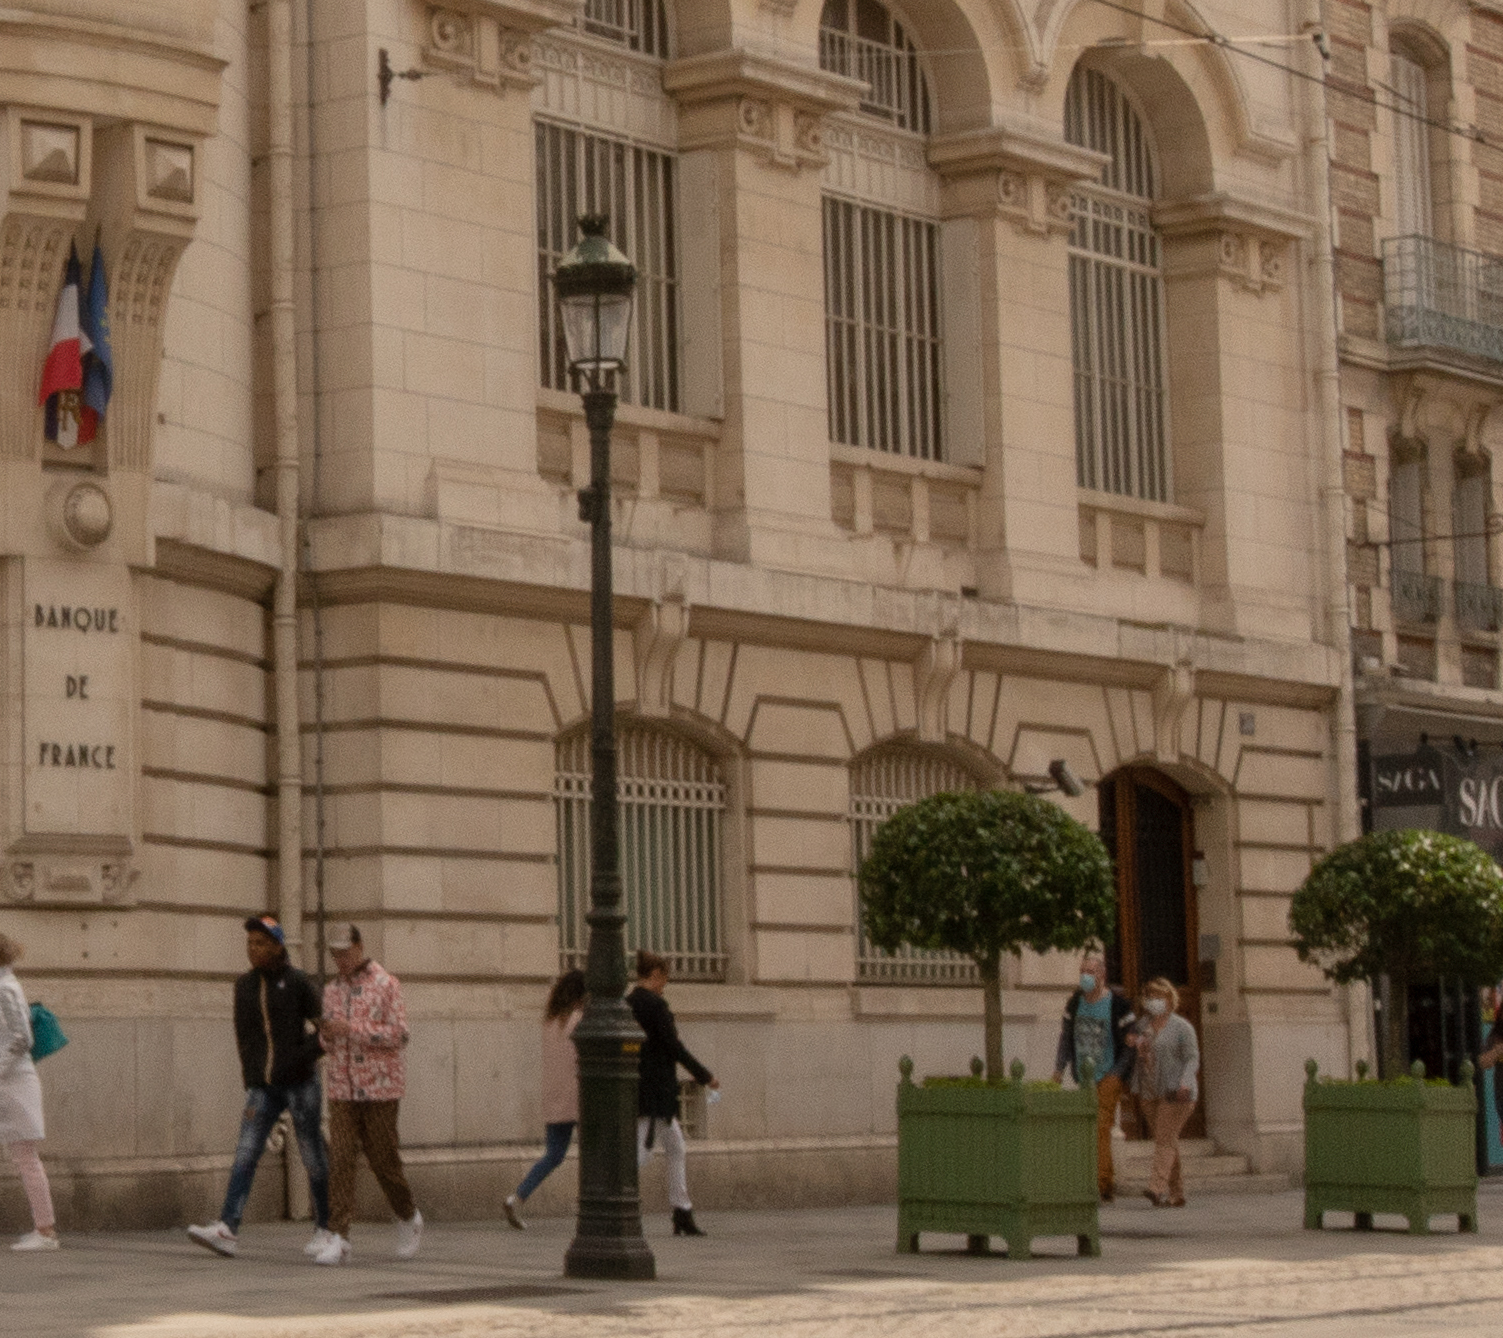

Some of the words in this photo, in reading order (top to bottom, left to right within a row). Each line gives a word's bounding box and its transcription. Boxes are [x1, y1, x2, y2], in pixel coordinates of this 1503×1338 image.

[34, 602, 119, 634] BANQUE
[65, 674, 90, 701] DE
[38, 742, 116, 771] FRANCE
[1377, 768, 1442, 793] SAGA
